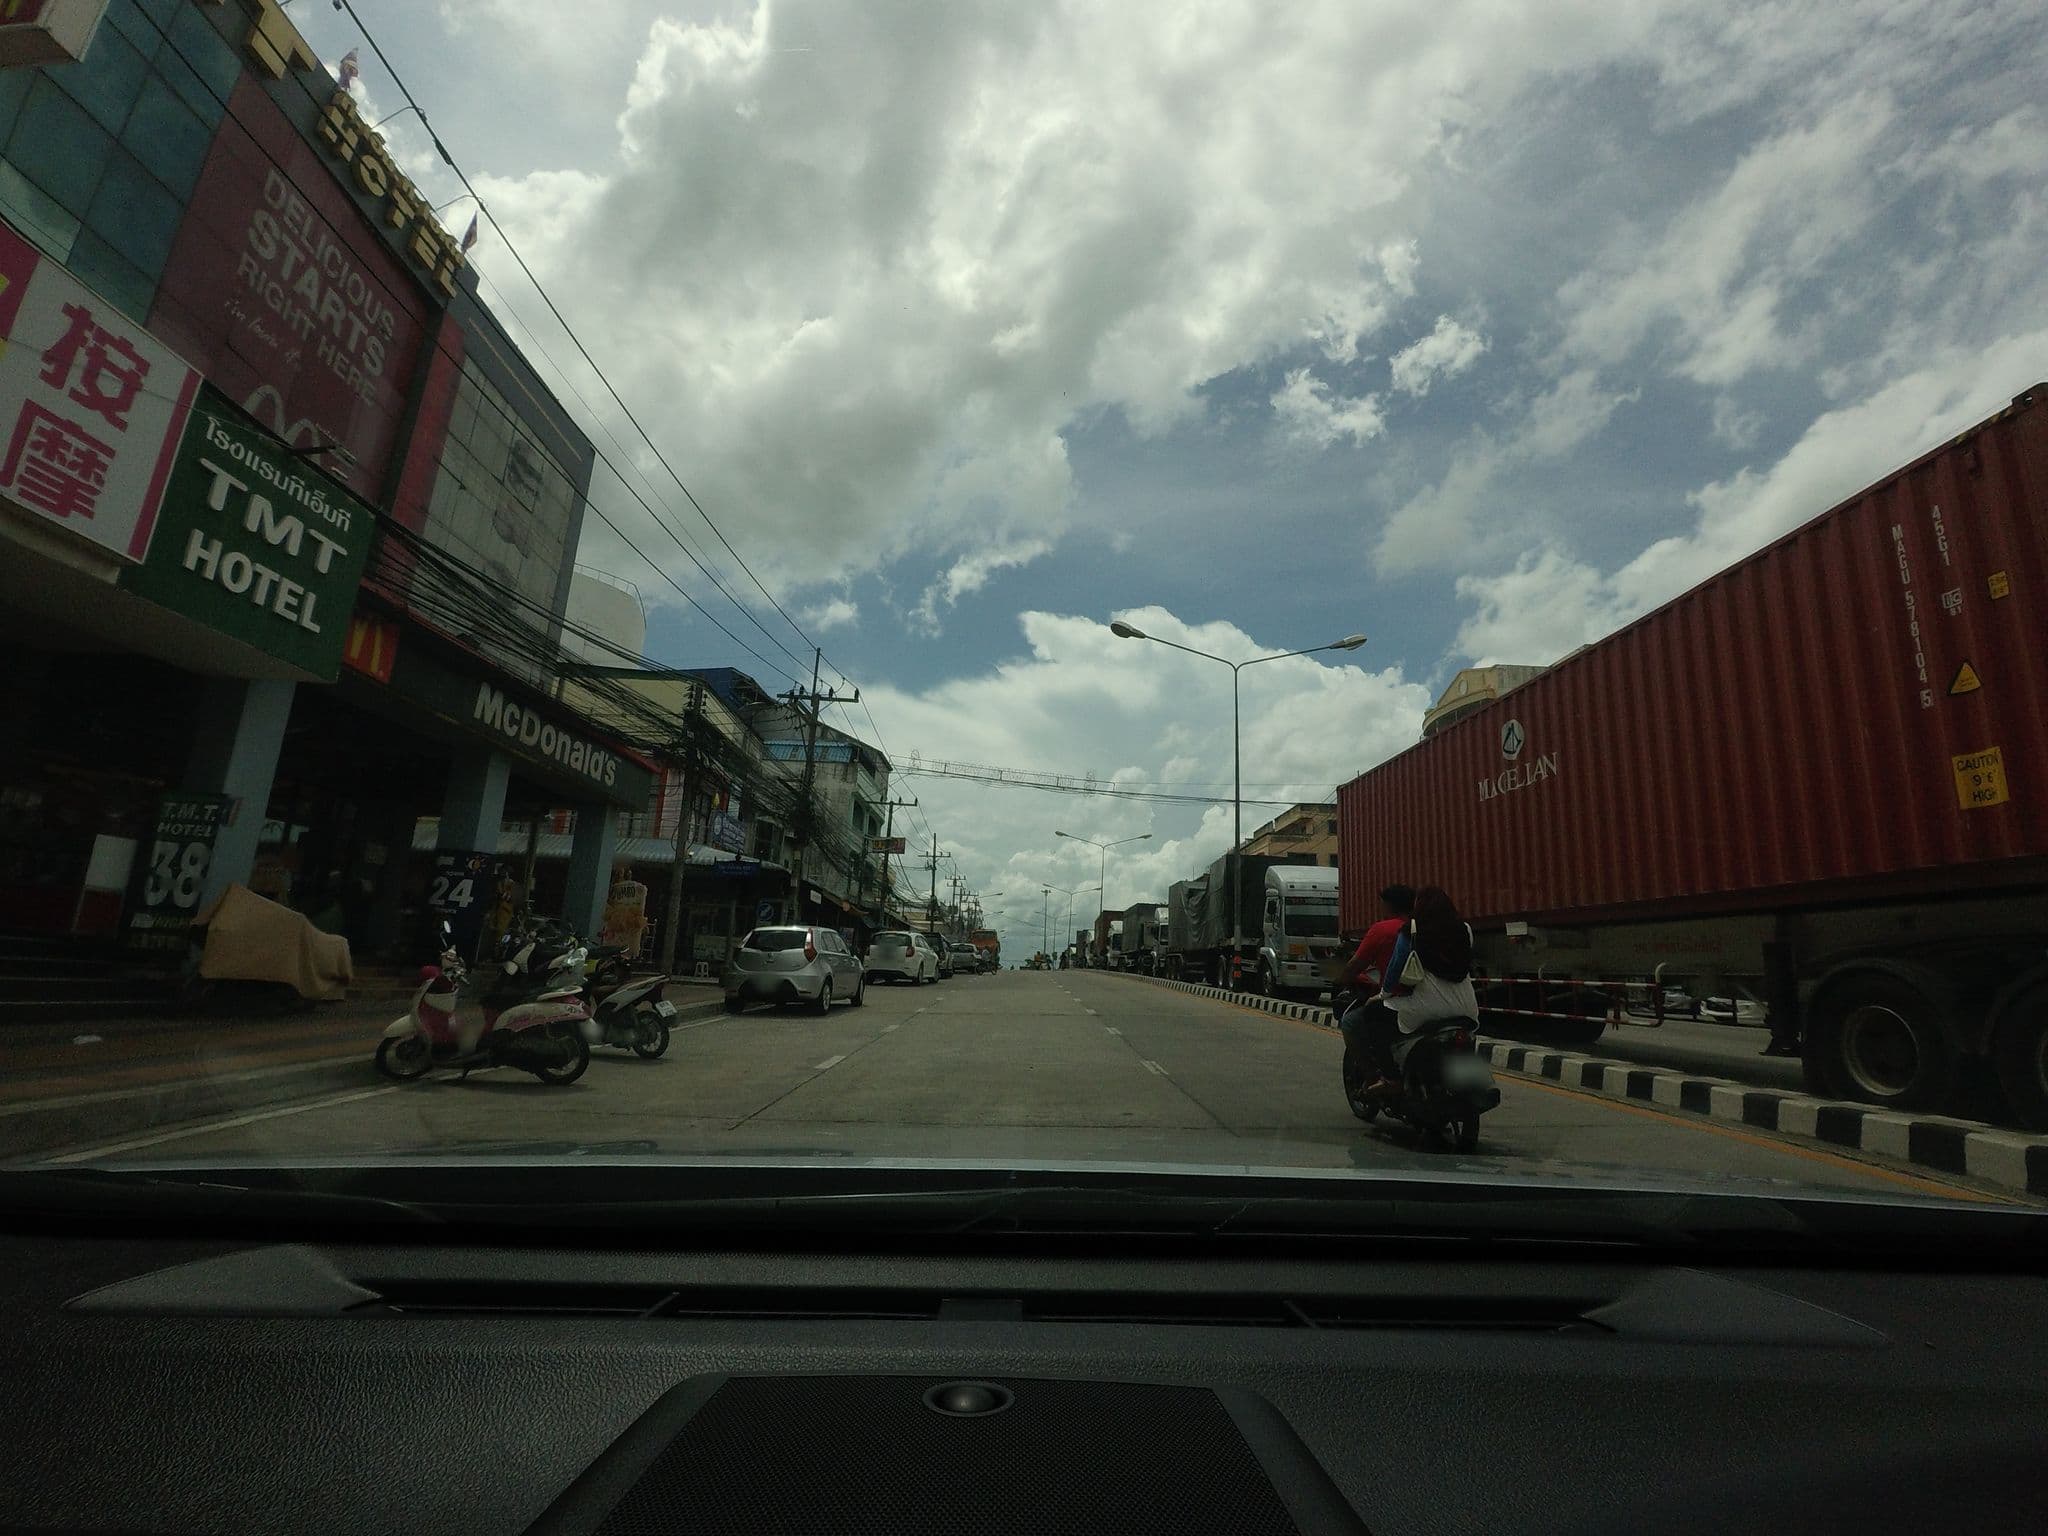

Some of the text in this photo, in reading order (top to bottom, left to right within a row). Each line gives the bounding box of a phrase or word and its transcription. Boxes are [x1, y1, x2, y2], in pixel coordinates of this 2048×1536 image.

[263, 167, 395, 341] DELICIOUS
[317, 104, 458, 300] HOTEL
[236, 252, 378, 406] RIGHT HERE
[249, 208, 386, 377] STARTS
[0, 302, 151, 519] 按摩
[182, 527, 321, 634] HOTEL
[198, 457, 349, 575] TMT
[472, 680, 617, 786] McDonald's
[157, 822, 214, 837] HOTEL
[428, 876, 474, 908] 24
